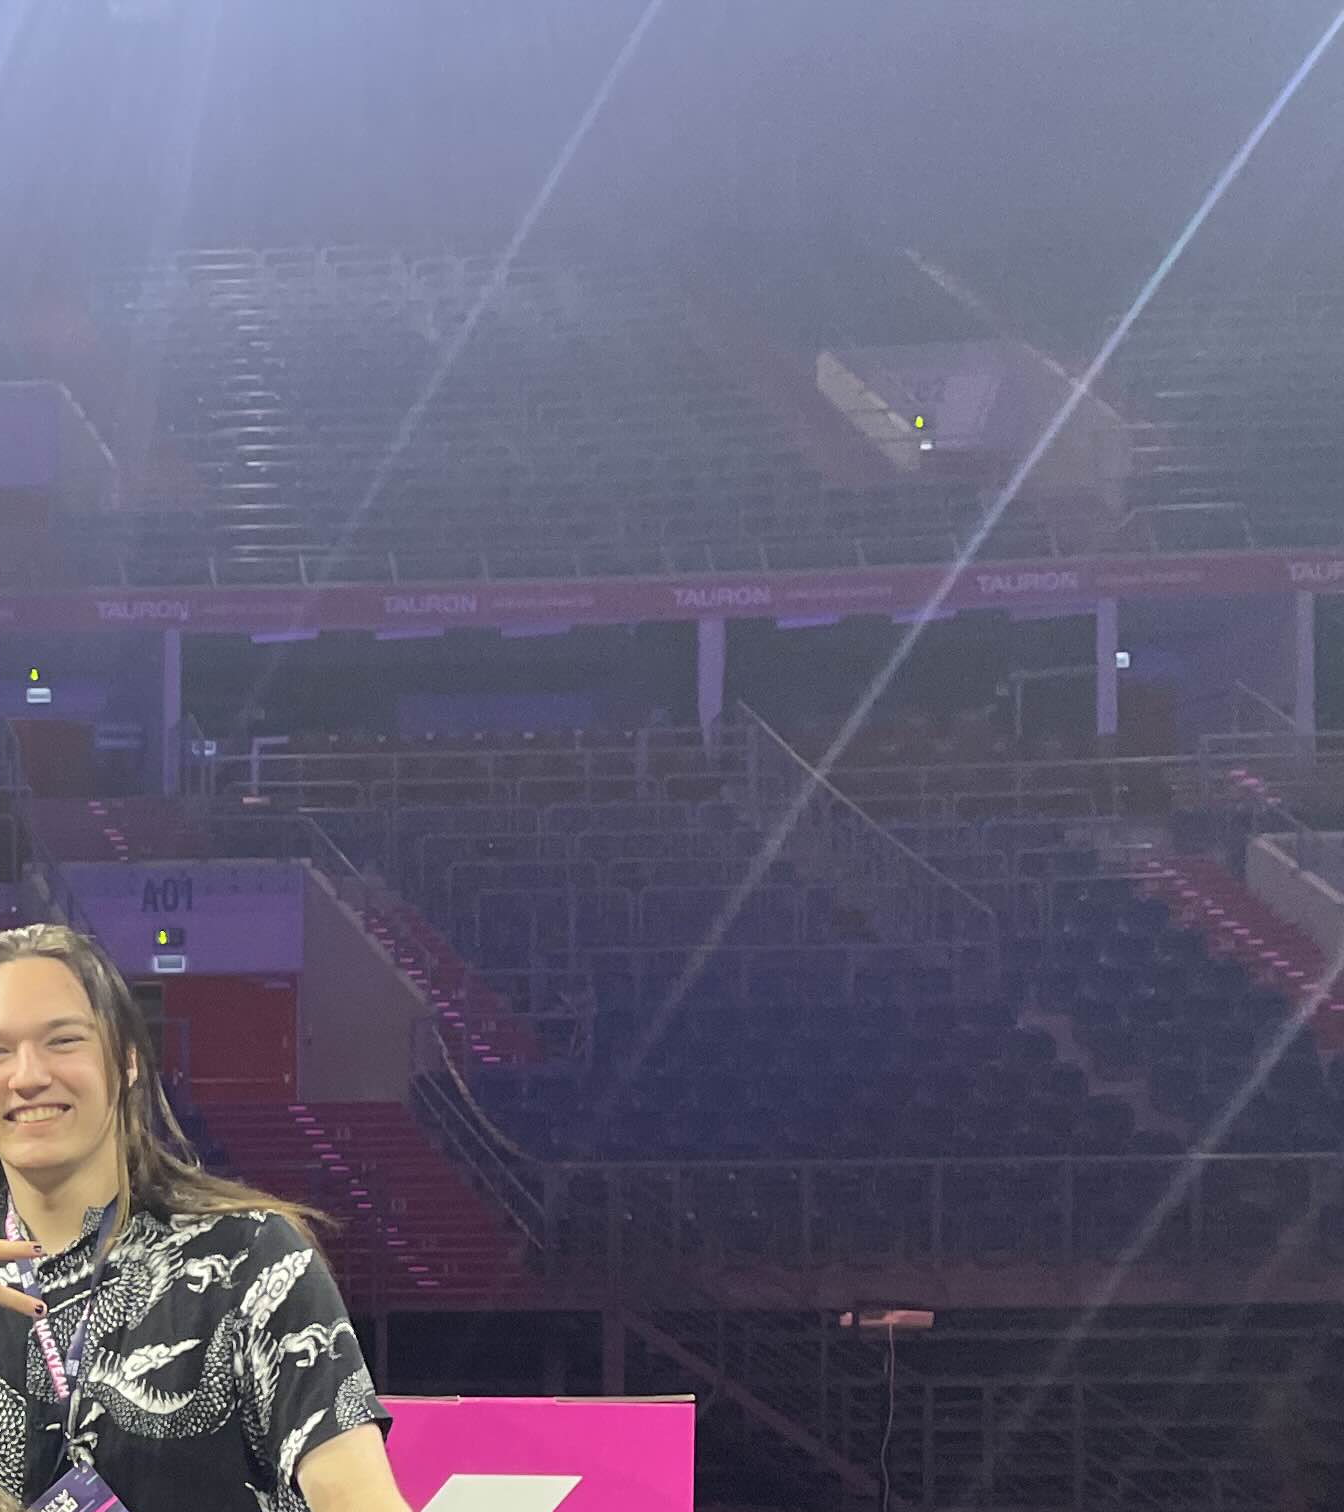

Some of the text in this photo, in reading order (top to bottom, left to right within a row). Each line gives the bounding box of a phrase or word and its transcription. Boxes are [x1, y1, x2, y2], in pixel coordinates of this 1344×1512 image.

[976, 572, 1080, 596] TAURON
[383, 594, 478, 614] TAURON
[673, 586, 771, 608] TAURON
[95, 600, 190, 622] TAURON
[141, 876, 194, 913] A01
[36, 1318, 71, 1399] HACKYEAH
